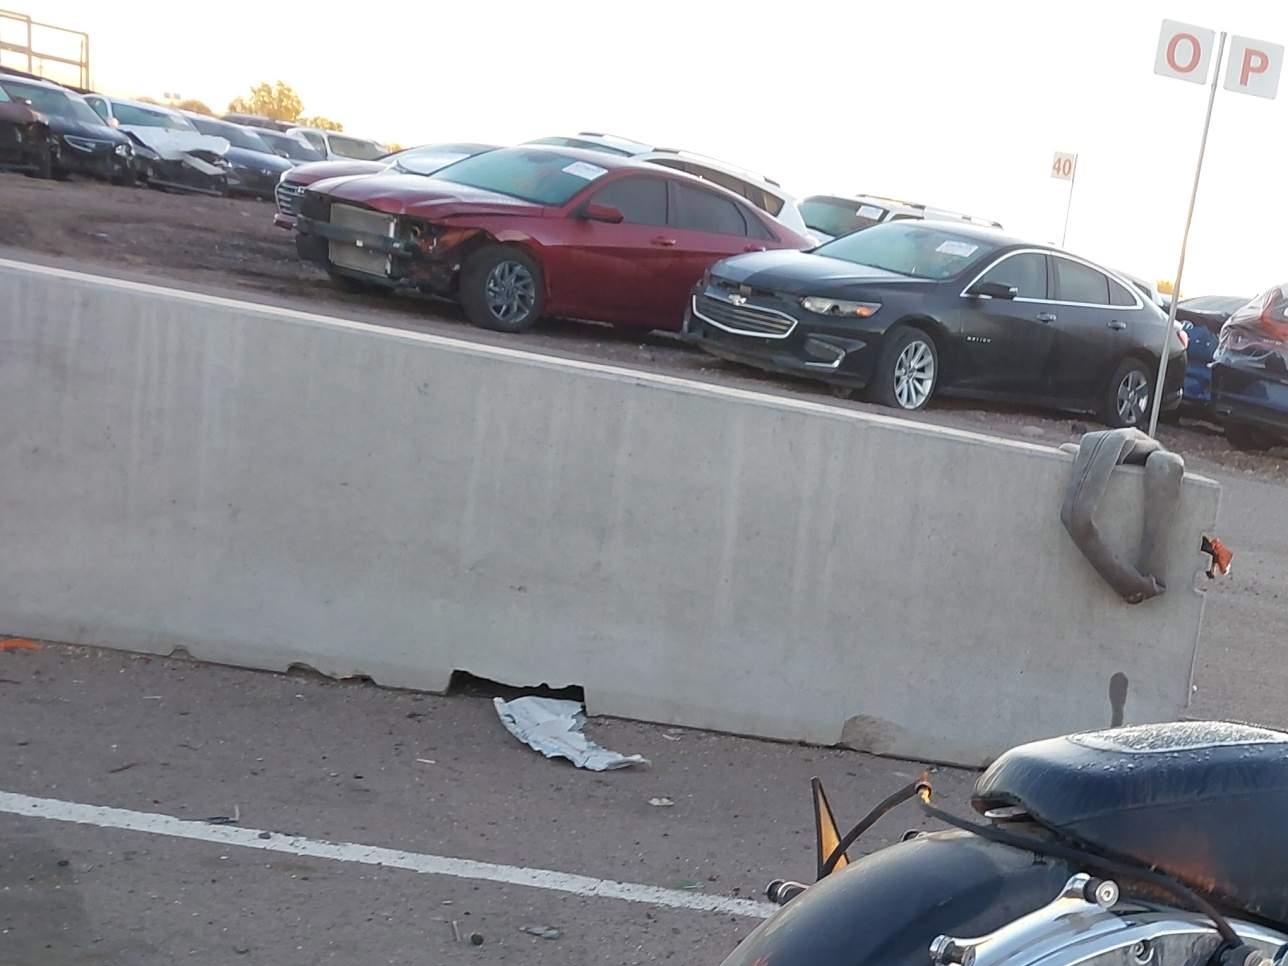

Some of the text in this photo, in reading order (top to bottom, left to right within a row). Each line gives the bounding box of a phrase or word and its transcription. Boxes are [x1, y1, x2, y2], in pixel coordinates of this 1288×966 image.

[1166, 32, 1201, 73] O
[1239, 47, 1269, 86] P
[1052, 157, 1072, 177] 40
